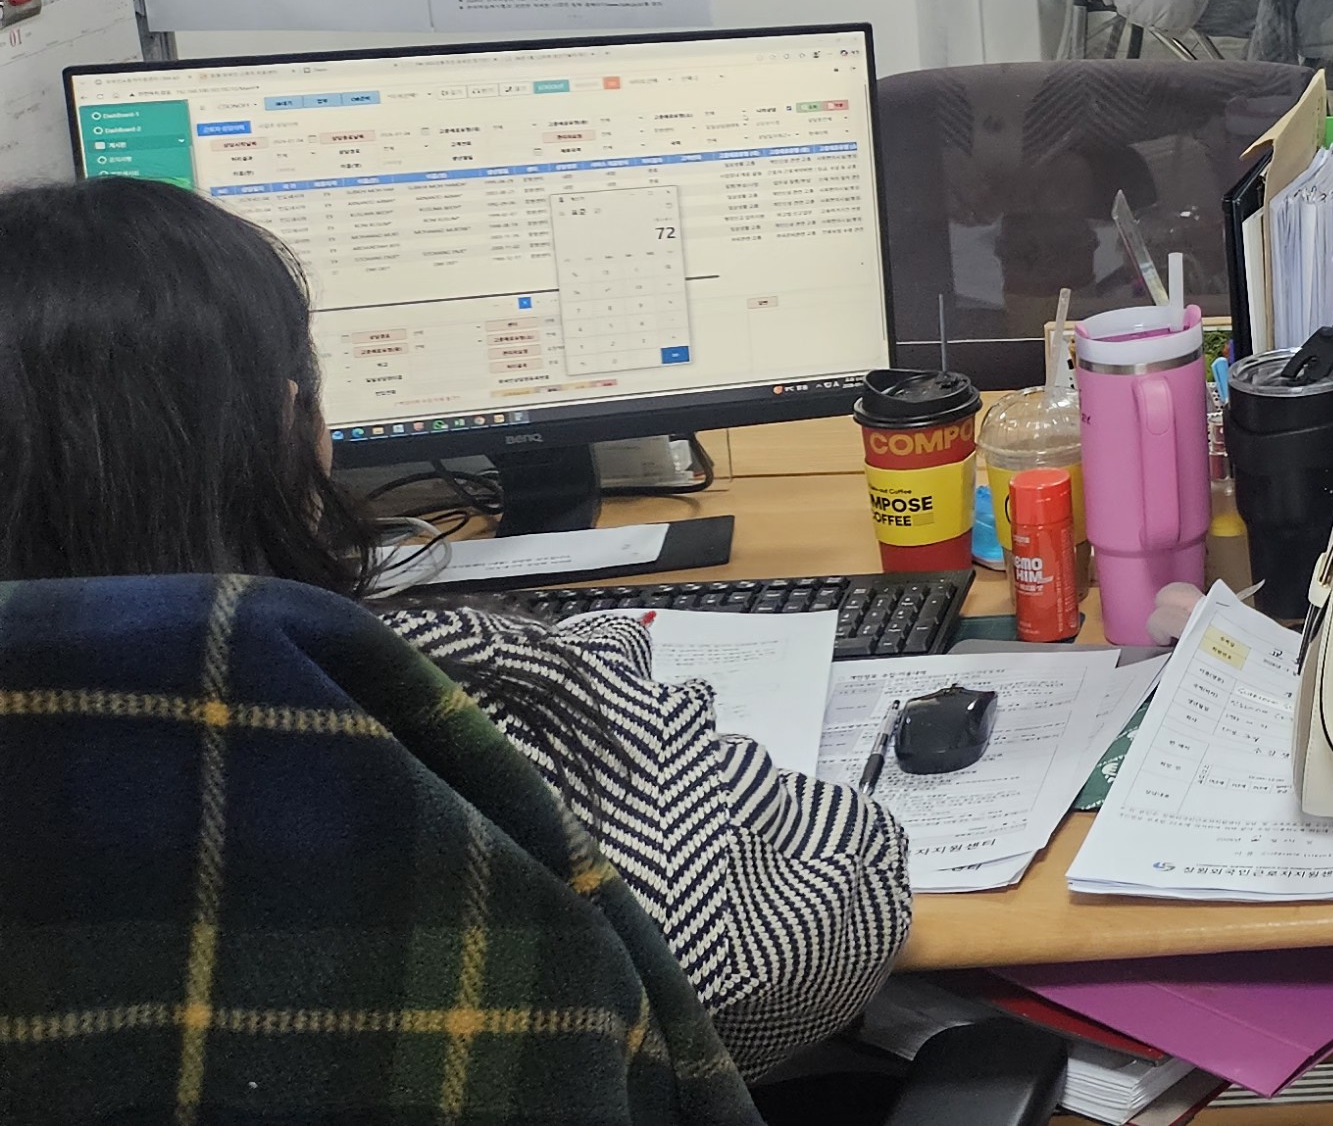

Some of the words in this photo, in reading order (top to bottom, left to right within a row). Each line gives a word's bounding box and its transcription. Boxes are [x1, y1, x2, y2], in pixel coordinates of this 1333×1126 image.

[655, 227, 676, 240] 72
[505, 433, 543, 445] BenQ
[869, 417, 974, 457] COMPO
[1016, 571, 1043, 582] HIM
